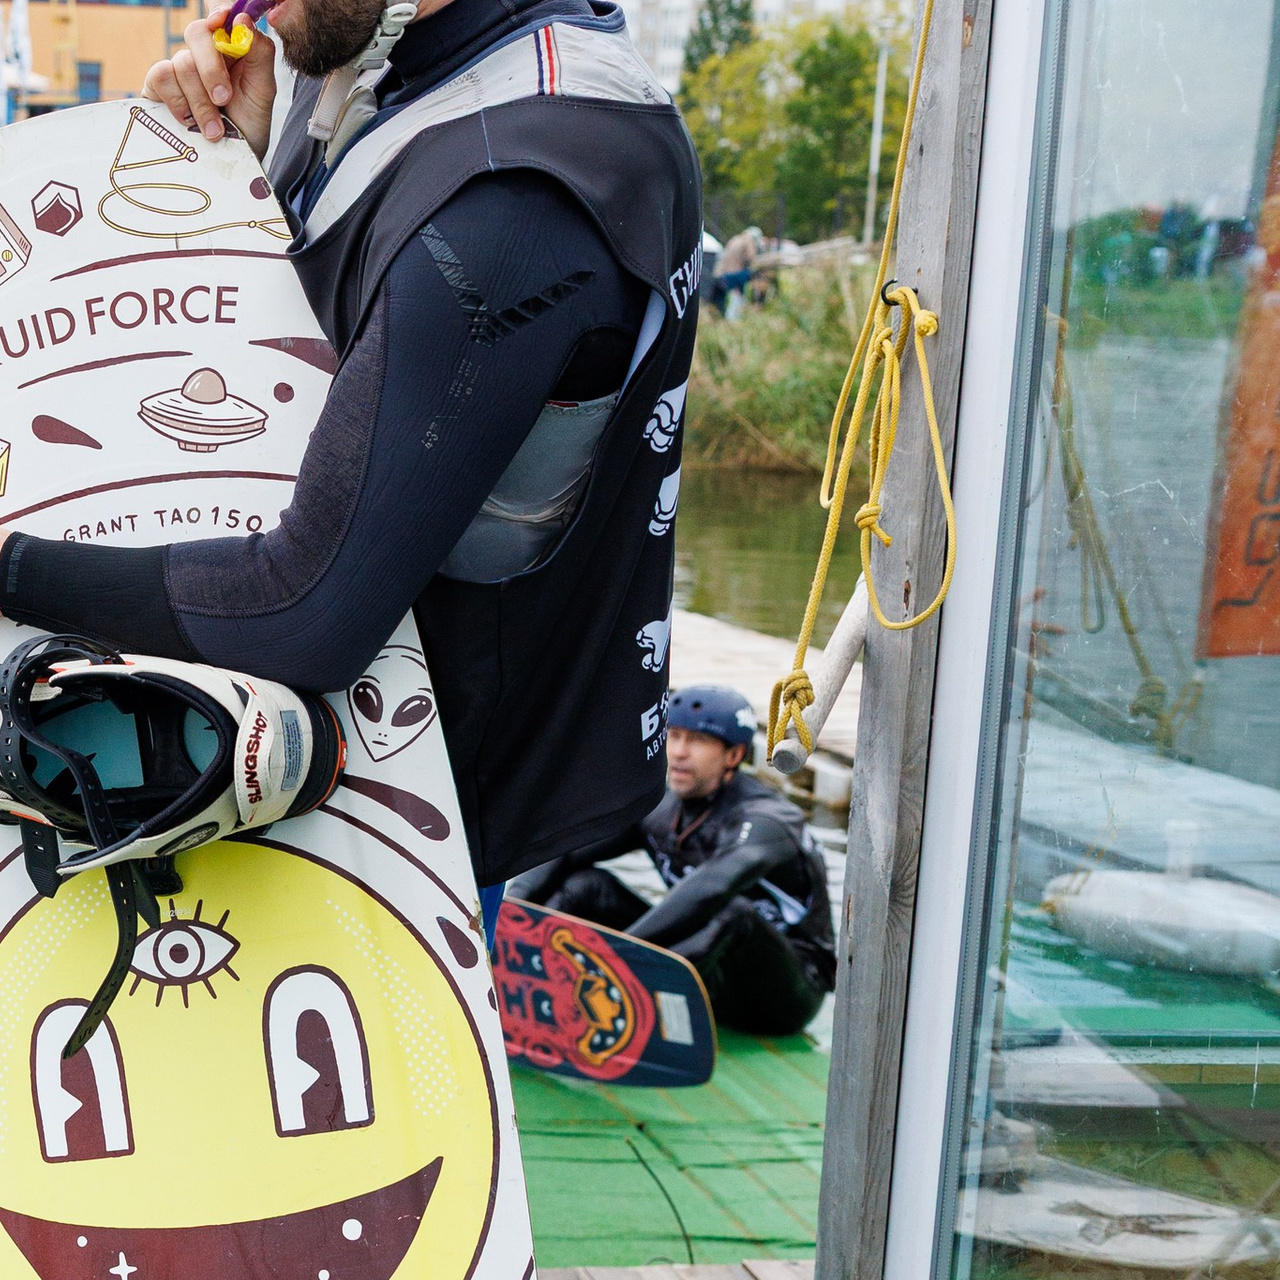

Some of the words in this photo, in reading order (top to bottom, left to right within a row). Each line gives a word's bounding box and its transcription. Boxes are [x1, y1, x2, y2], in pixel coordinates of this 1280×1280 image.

[84, 285, 239, 336] FORCE
[63, 514, 139, 543] GRANT
[154, 507, 202, 526] TAO
[211, 506, 263, 533] 150
[244, 710, 268, 804] SLINGSHOT
